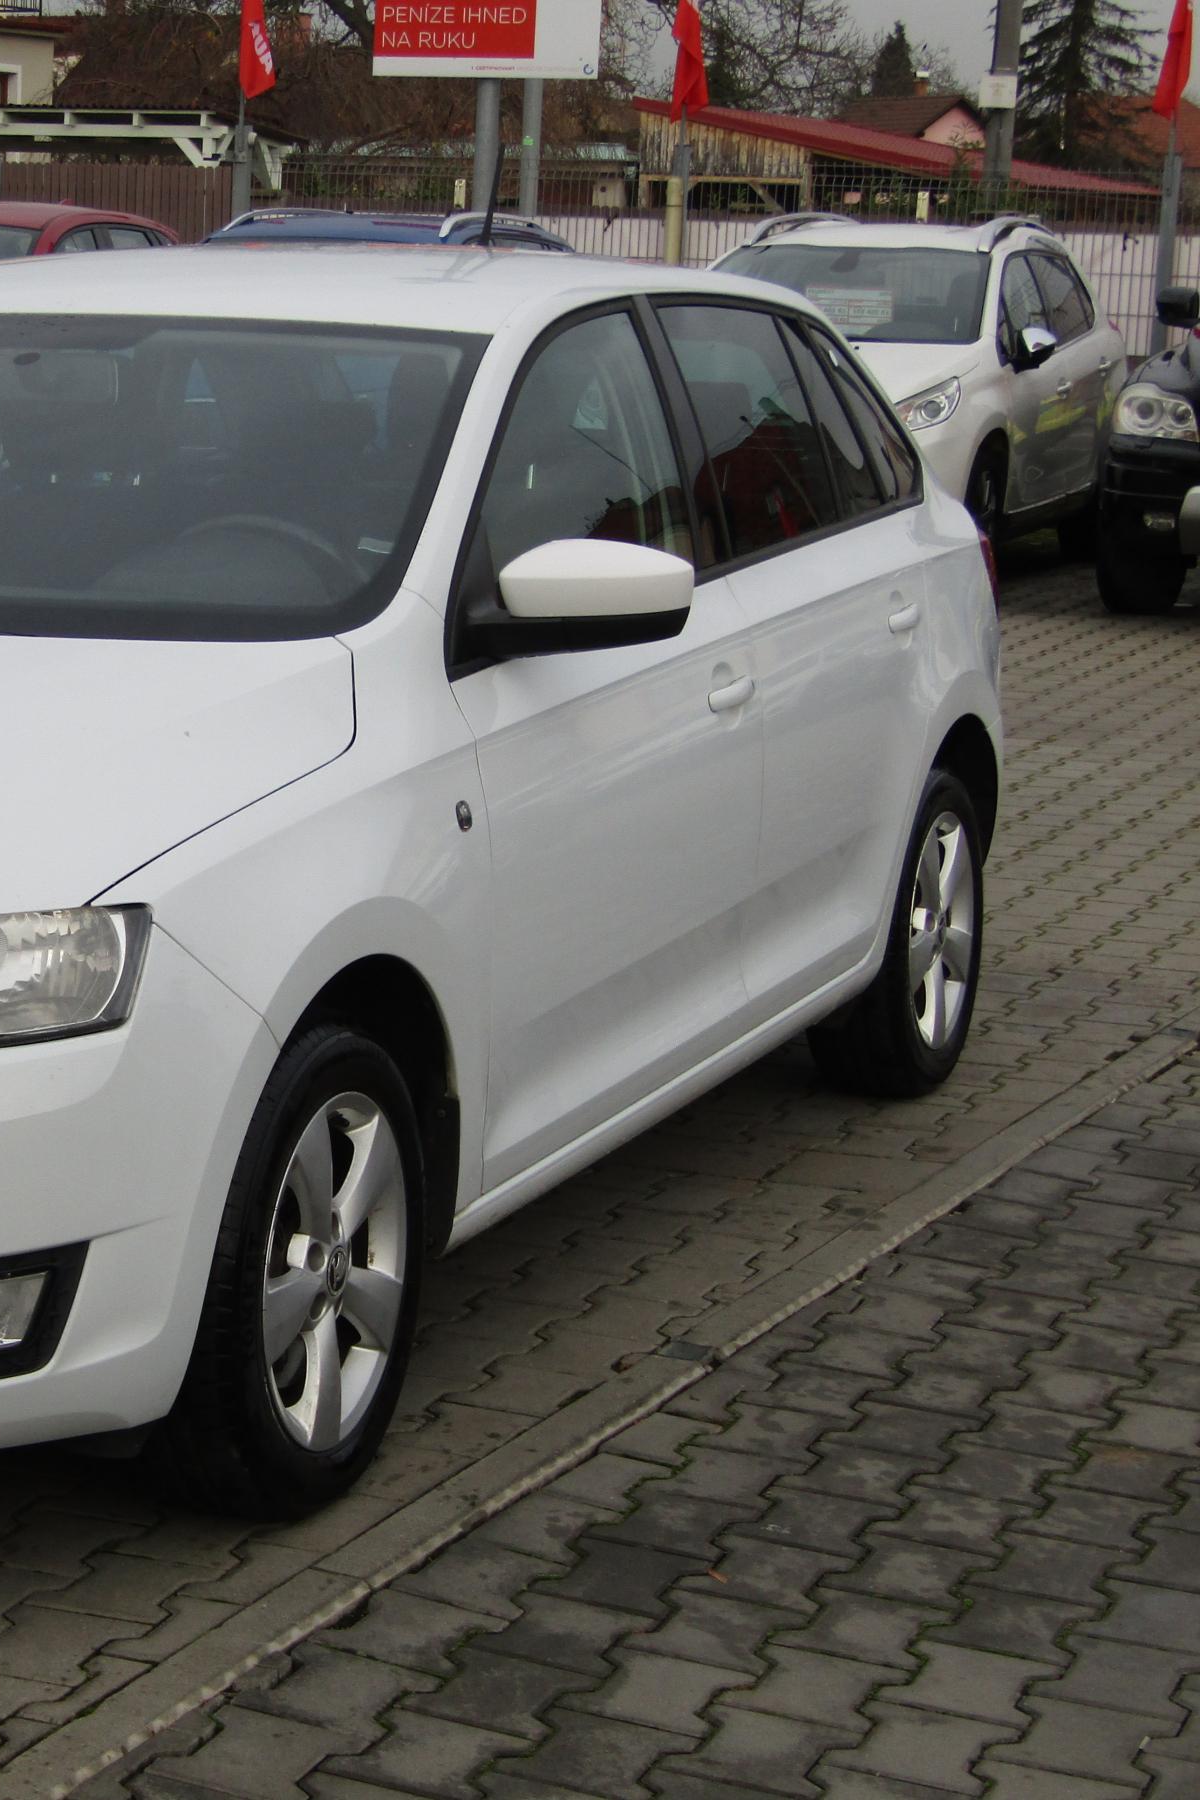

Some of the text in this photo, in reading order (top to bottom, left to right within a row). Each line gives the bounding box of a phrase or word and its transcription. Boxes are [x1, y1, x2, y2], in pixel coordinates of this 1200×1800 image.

[382, 4, 528, 24] PENÍZE IHNED
[381, 31, 476, 49] NA RUKU
